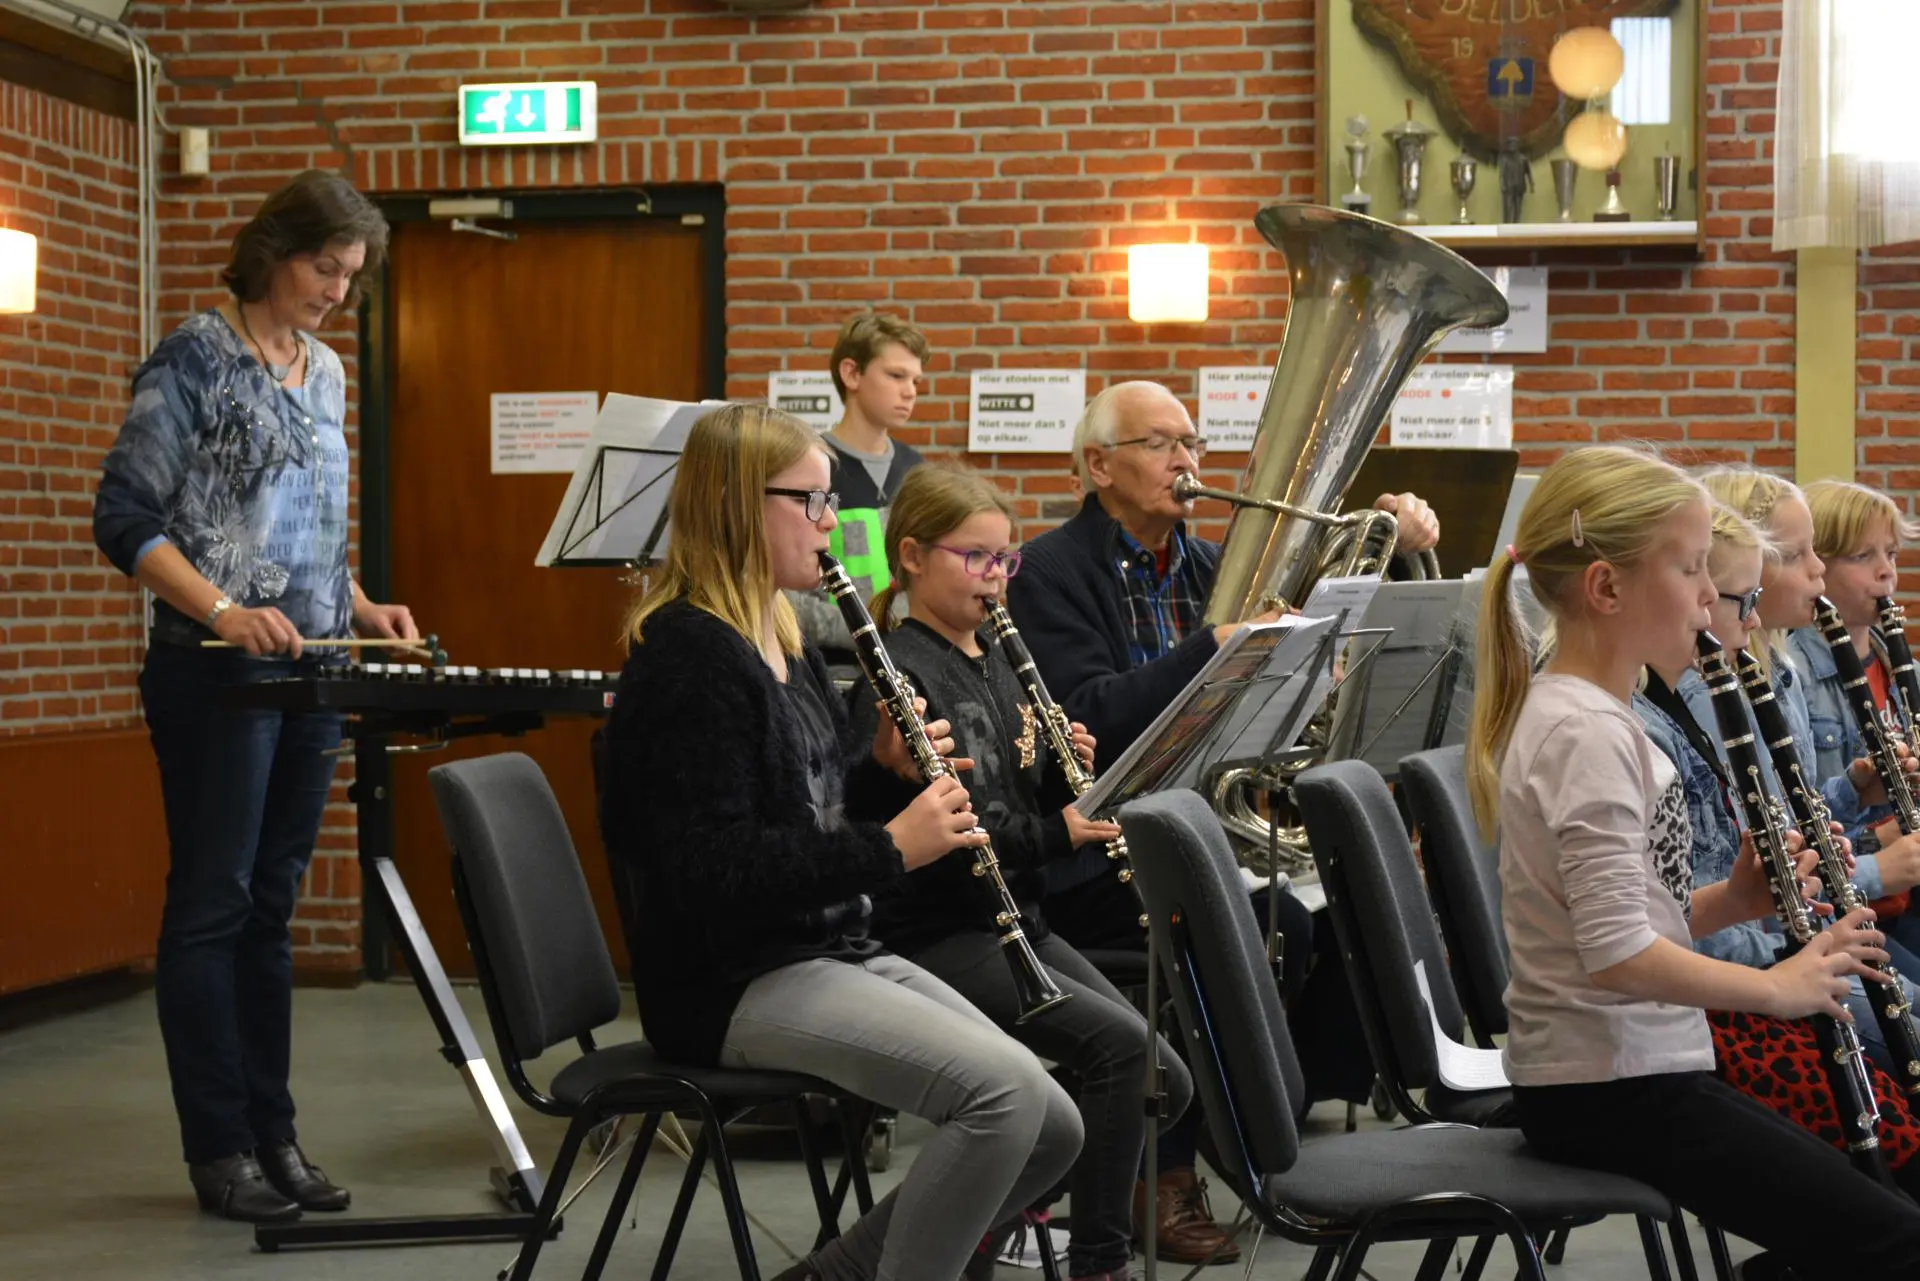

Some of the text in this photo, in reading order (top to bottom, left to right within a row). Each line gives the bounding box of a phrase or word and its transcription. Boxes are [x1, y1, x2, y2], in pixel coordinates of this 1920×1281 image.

[1451, 37, 1473, 59] 19
[978, 374, 1070, 383] Hier stoelen met
[1208, 373, 1230, 381] Hier
[1207, 391, 1238, 400] RODE
[980, 398, 1017, 409] WITTE
[978, 419, 1000, 428] Niet
[1003, 420, 1031, 428] meer
[1035, 419, 1055, 428] dan
[1207, 418, 1258, 427] Niet mee
[1400, 416, 1423, 424] Niet
[1427, 416, 1455, 424] meer
[1460, 416, 1480, 425] dan
[977, 433, 991, 443] op
[1206, 432, 1254, 441] op elkaa
[1399, 431, 1413, 439] op
